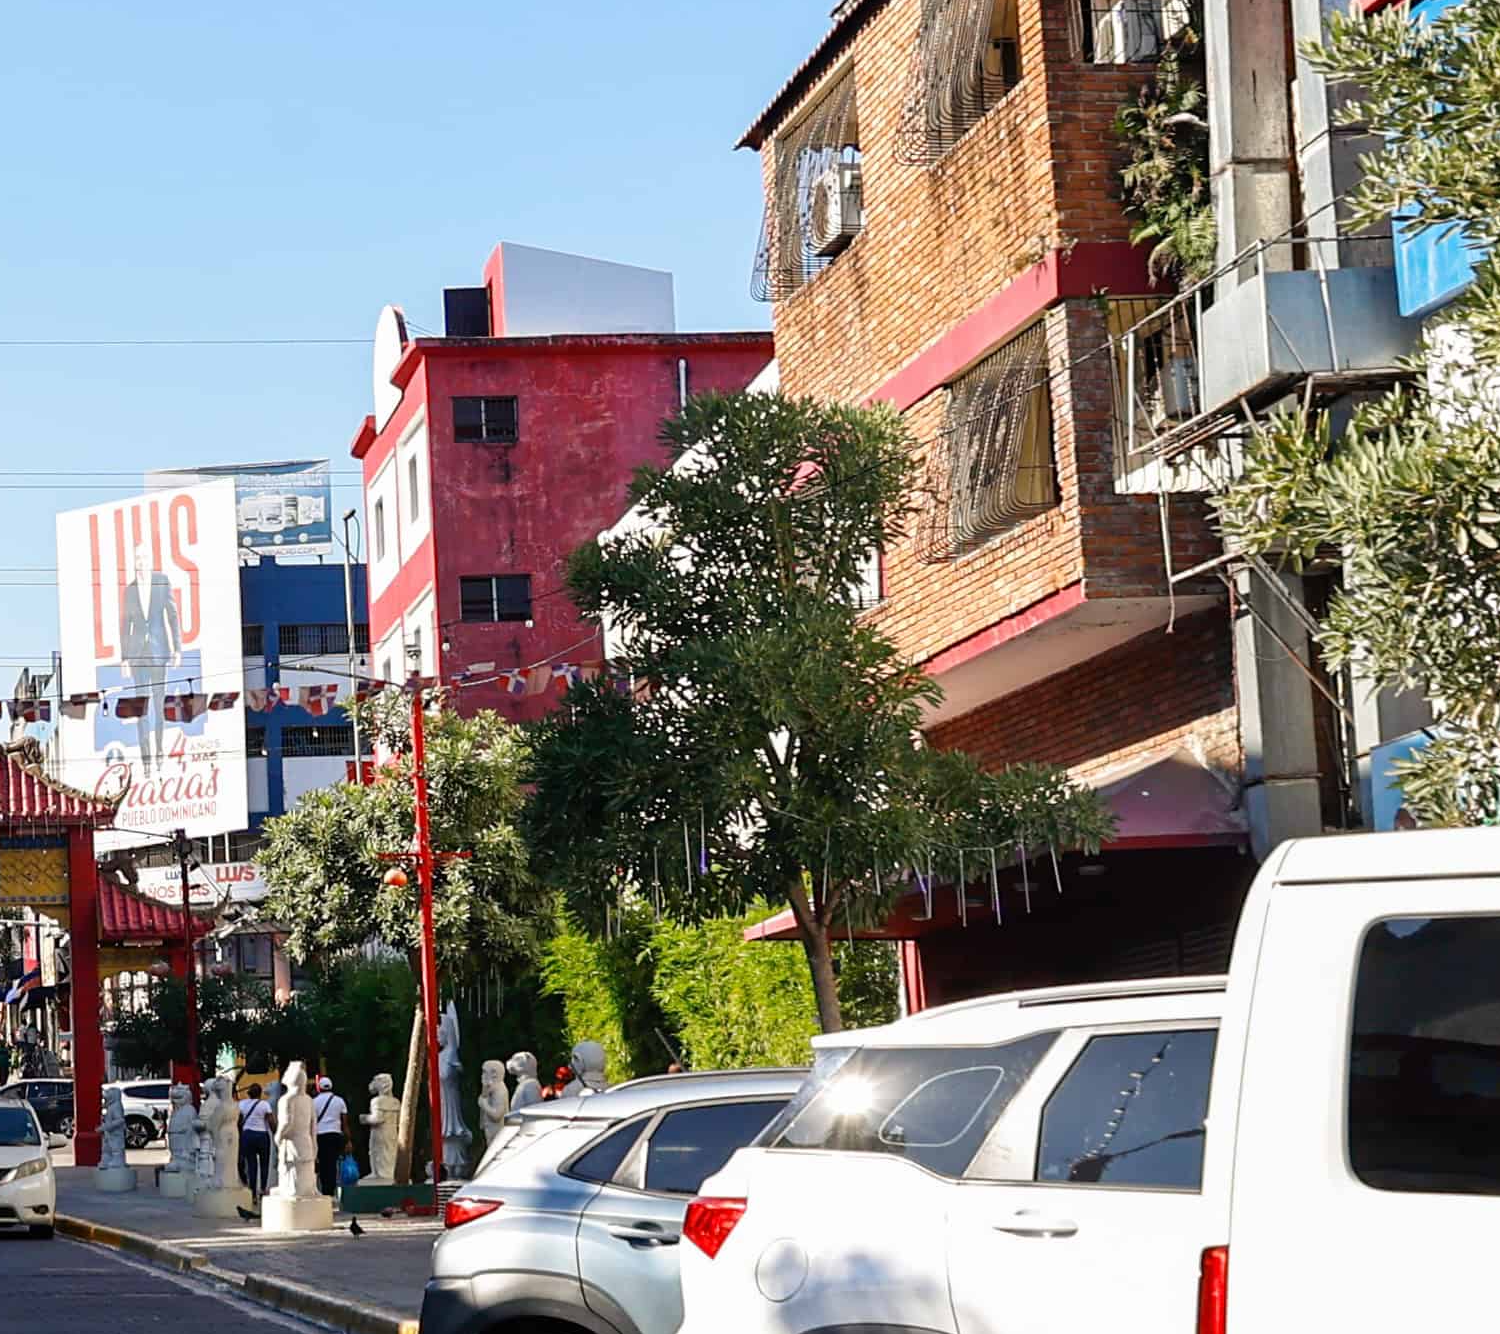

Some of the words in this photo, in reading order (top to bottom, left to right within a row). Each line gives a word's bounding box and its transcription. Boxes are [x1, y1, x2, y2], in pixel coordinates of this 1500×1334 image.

[88, 493, 201, 659] LUIS
[121, 808, 156, 828] PUEBLO
[159, 800, 218, 822] DOMINICANO
